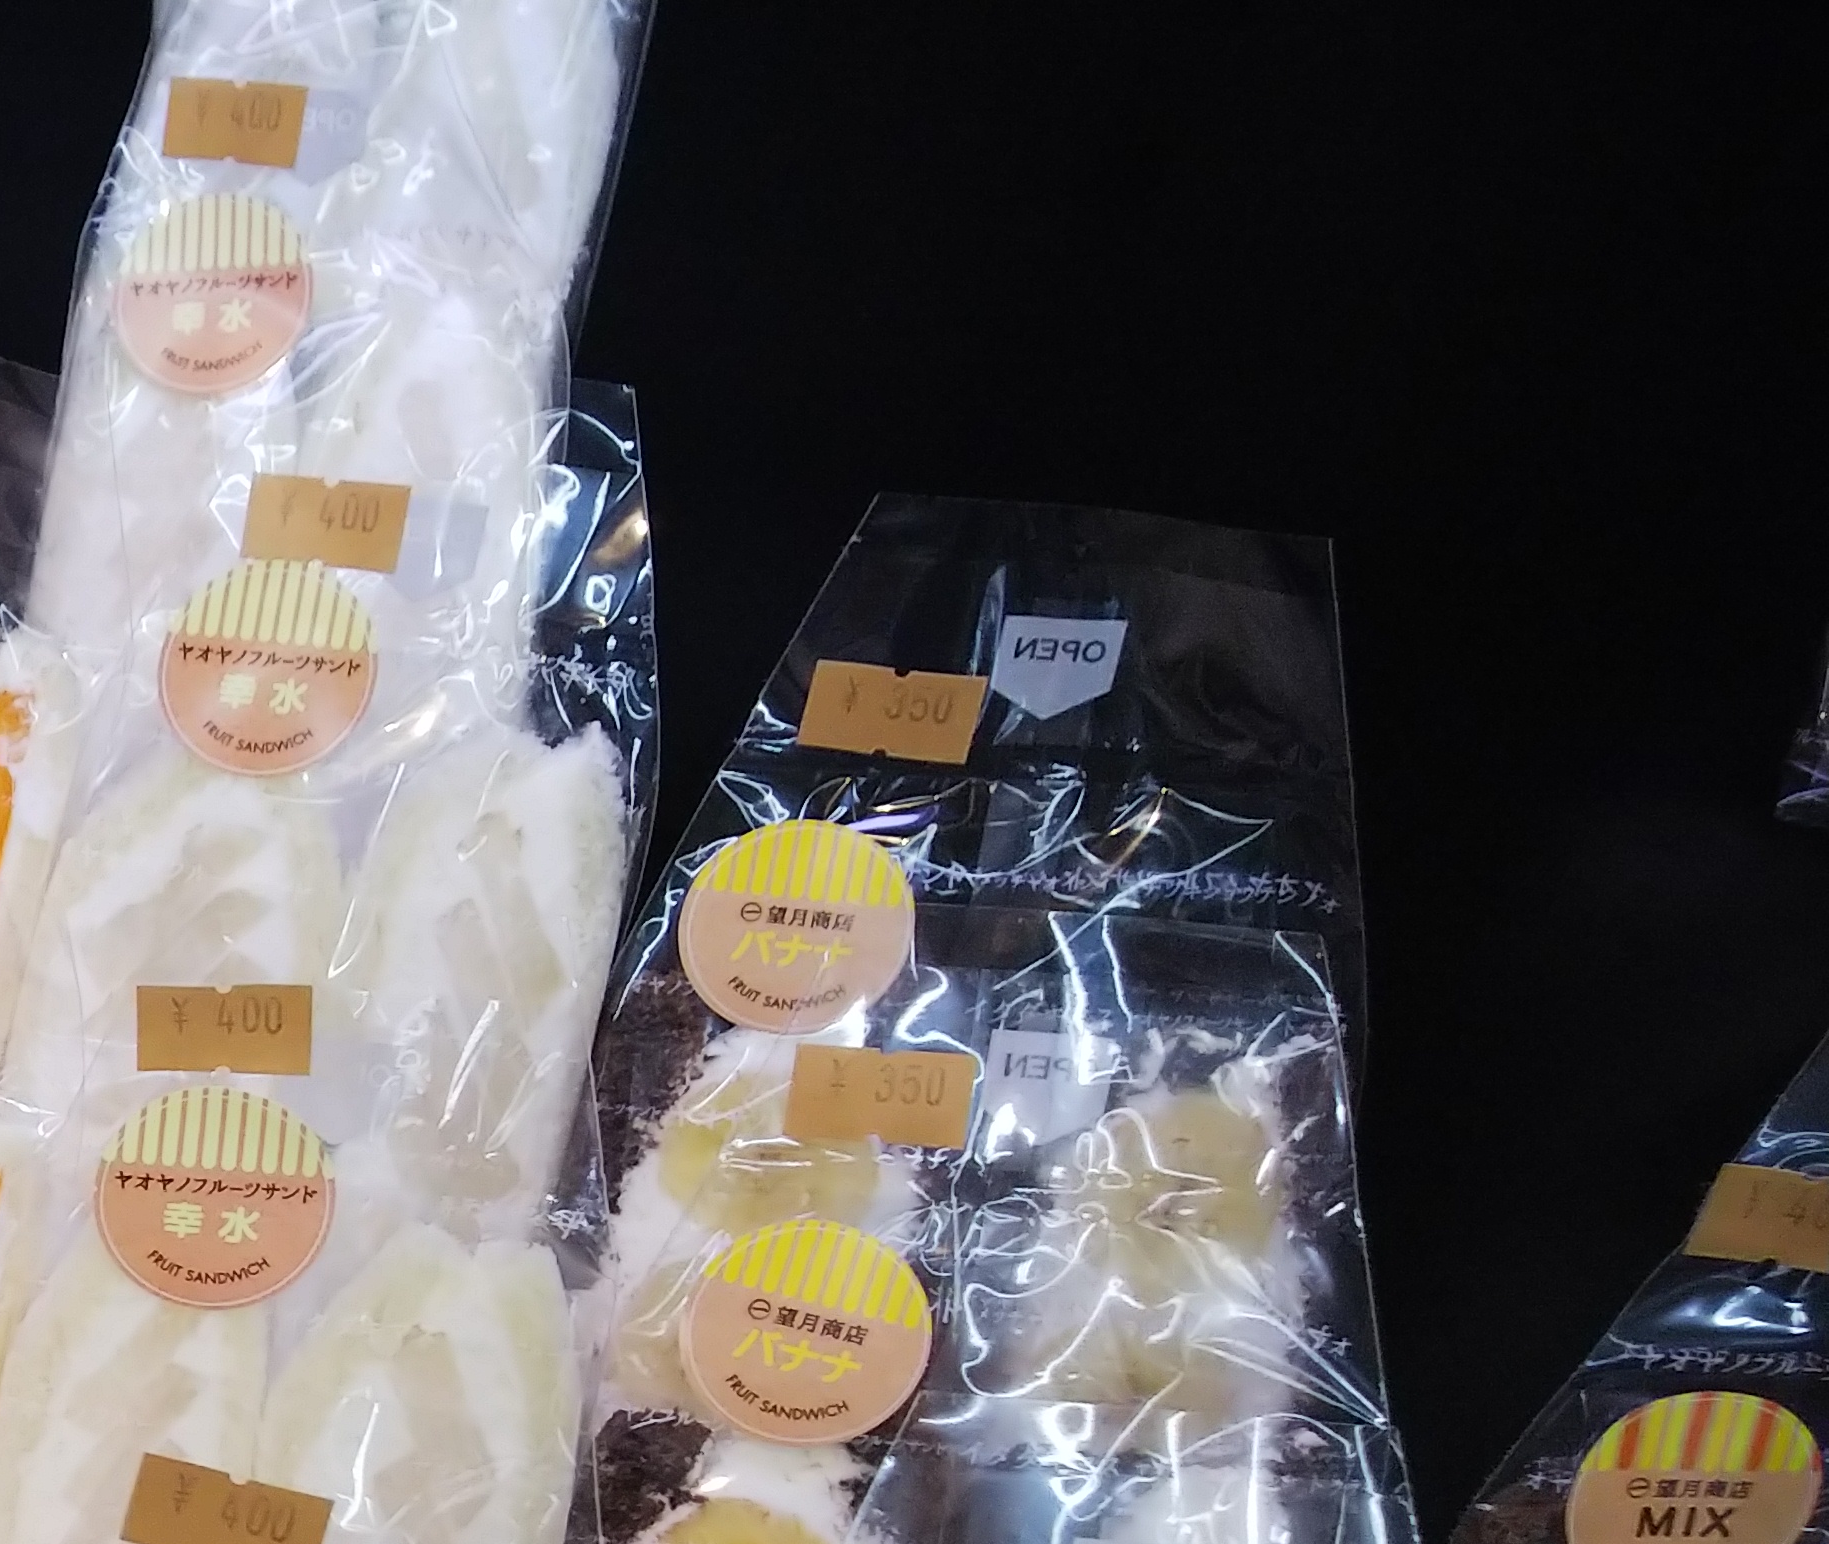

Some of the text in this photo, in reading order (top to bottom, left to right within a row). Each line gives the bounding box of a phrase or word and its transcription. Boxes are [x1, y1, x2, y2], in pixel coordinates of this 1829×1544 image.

[130, 271, 298, 298] ヤオヤノフルーツサンド
[318, 493, 381, 533] 400
[180, 642, 361, 678] ヤオヤノフルーツサンド
[218, 672, 309, 716] 幸水
[884, 689, 956, 726] 350
[203, 719, 314, 755] FRUIT SANDWICH
[766, 906, 855, 932] 望月商店
[730, 929, 853, 968] バナナ
[729, 976, 846, 1012] FRUIT SANWICH
[171, 996, 284, 1036] ¥ 400
[829, 1057, 947, 1106] ¥ 350
[115, 1171, 319, 1203] ヤオヤノフルーツサンド
[163, 1201, 261, 1244] 幸水
[147, 1250, 271, 1285] FRUIT SANDWICH
[774, 1306, 869, 1346] 望月商店
[732, 1327, 862, 1384] バナナ
[725, 1374, 850, 1422] FRUIT SANDWICH
[173, 1472, 296, 1543] ¥ 400
[1654, 1478, 1755, 1500] 望月商店
[1635, 1505, 1737, 1540] MIX
